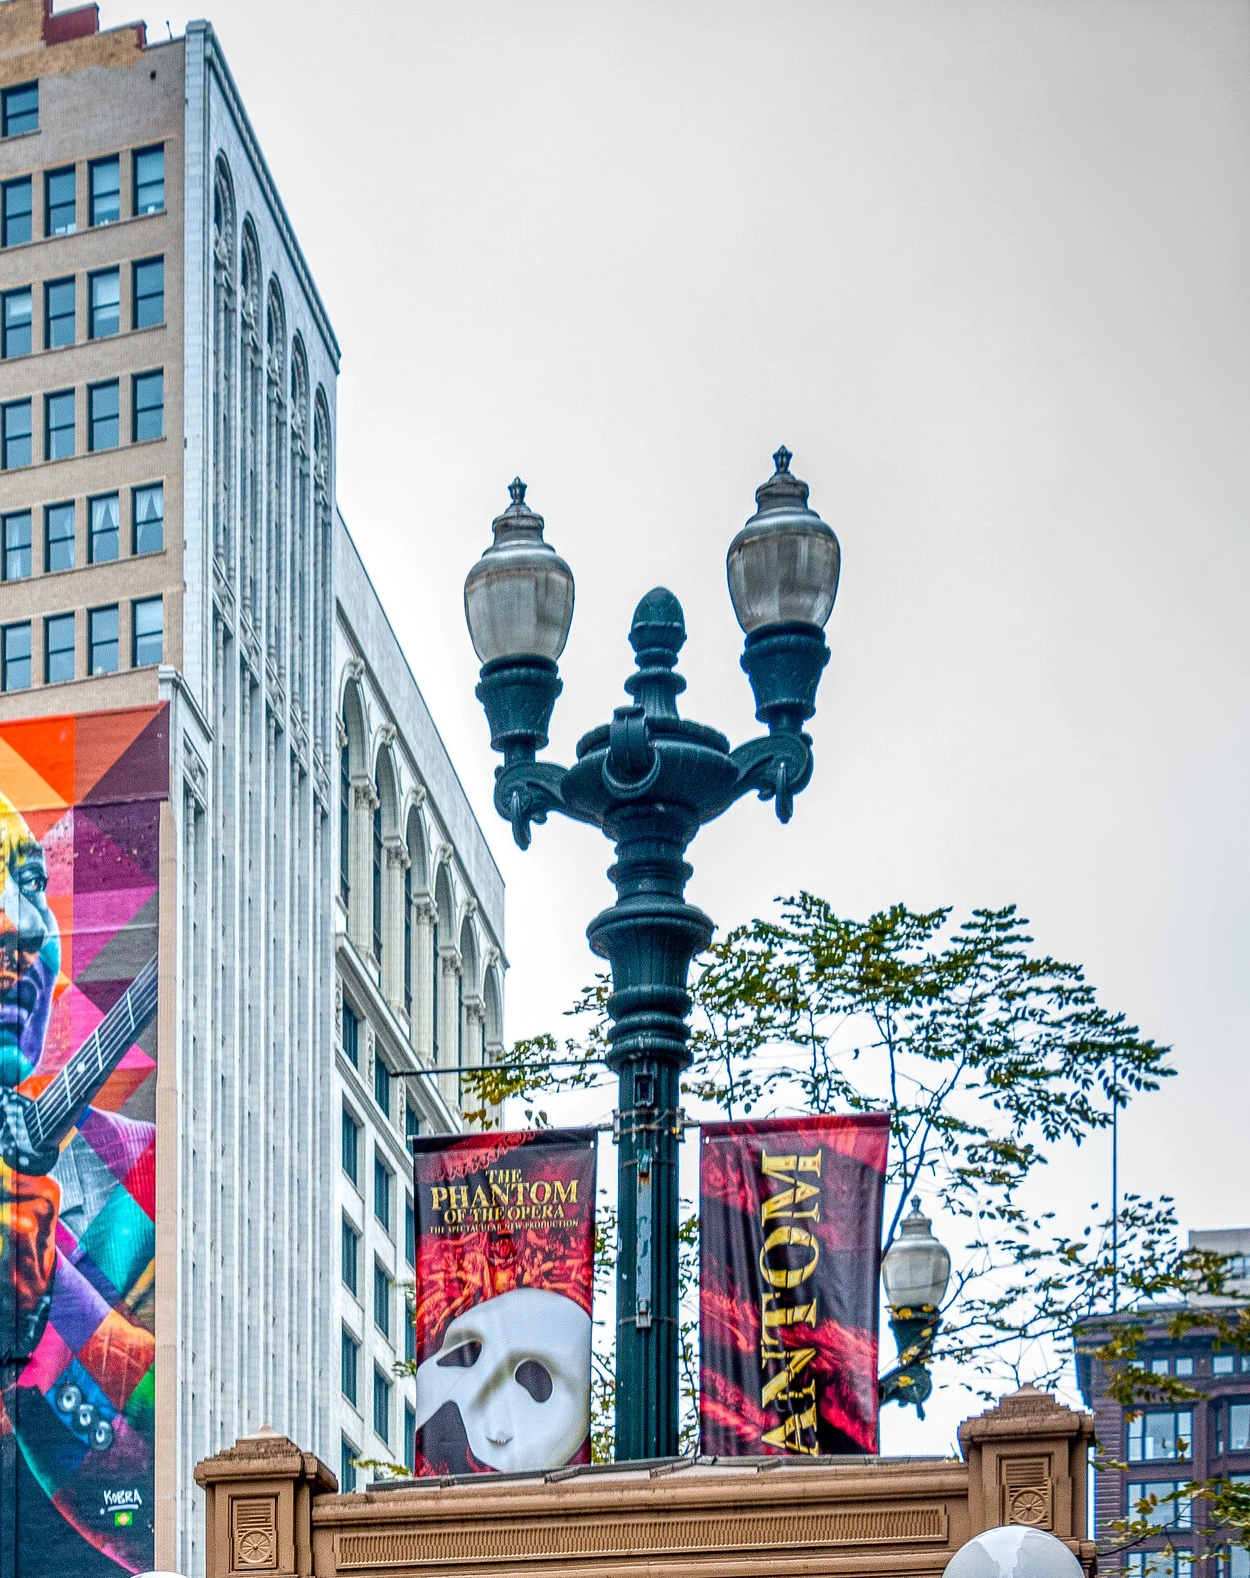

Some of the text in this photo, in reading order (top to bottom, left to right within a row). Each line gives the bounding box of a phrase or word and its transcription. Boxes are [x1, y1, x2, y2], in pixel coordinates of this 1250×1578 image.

[485, 1168, 522, 1184] THE
[430, 1179, 580, 1211] PHANTOM
[444, 1204, 565, 1225] OF THE OPERA
[430, 1219, 579, 1235] THE SPECTACULAR NEW PRODUCTION
[103, 1488, 142, 1505] KOBRA
